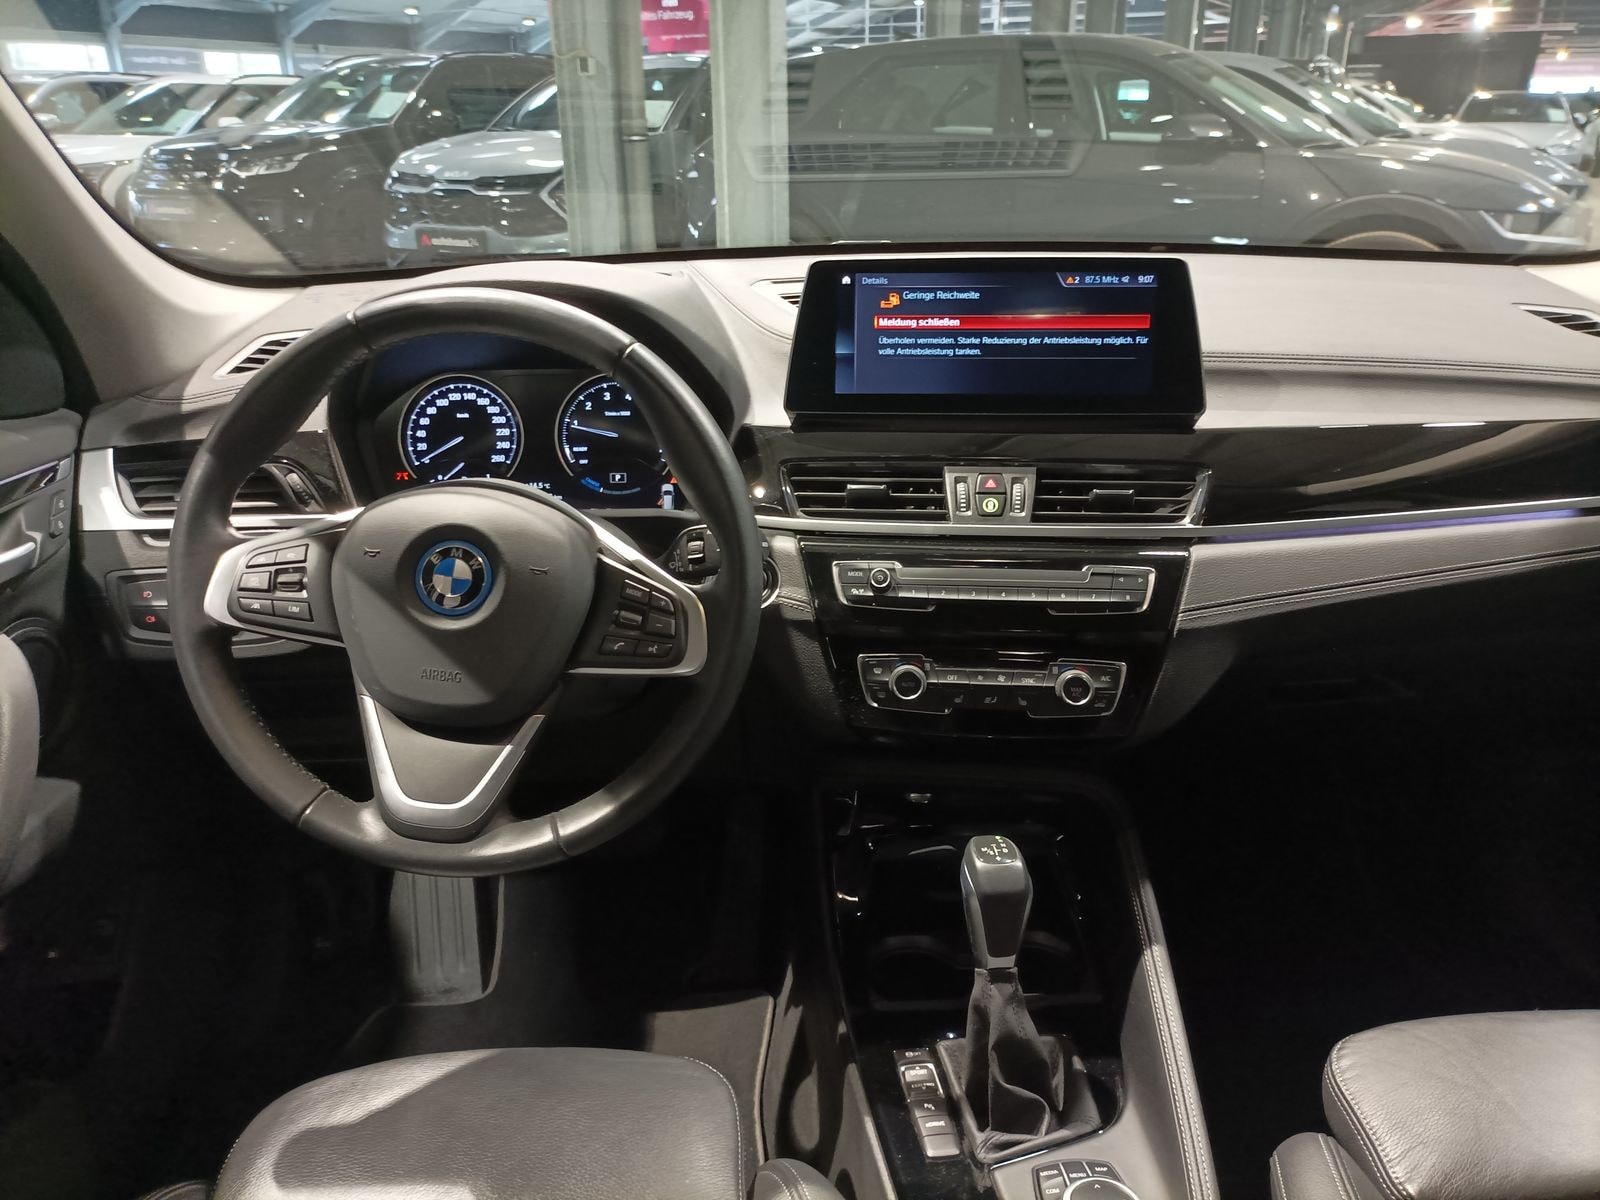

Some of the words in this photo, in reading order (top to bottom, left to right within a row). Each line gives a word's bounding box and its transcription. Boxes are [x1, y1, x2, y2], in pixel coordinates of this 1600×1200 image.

[861, 277, 889, 285] Details
[1084, 275, 1101, 283] 87.5
[1101, 275, 1119, 283] MHz
[1137, 275, 1154, 283] 9:07
[902, 290, 935, 301] Geringe
[936, 290, 980, 300] Reichweite
[878, 317, 917, 328] Meldung
[918, 317, 961, 327] schließen
[878, 335, 916, 345] Überholen
[917, 336, 956, 345] vermeiden.
[957, 336, 981, 345] Starke
[982, 336, 1028, 346] Reduzierung
[1028, 336, 1042, 345] der
[1042, 336, 1102, 346] Antriebsleistung
[1103, 336, 1135, 346] möglich.
[1136, 335, 1149, 345] Für
[878, 347, 895, 355] volle
[896, 347, 954, 357] Antriebsleistung
[955, 347, 981, 355] tanken.
[448, 393, 462, 401] 120
[603, 392, 611, 401] 3
[625, 393, 632, 401] 4
[435, 399, 449, 407] 100
[476, 398, 490, 406] 160
[585, 402, 593, 410] 2
[426, 407, 437, 415] 80
[486, 406, 500, 414] 180
[419, 417, 430, 425] 60
[491, 416, 507, 424] 200
[415, 430, 427, 438] 40
[495, 428, 510, 436] 220
[416, 443, 428, 451] 20
[496, 441, 511, 449] 240
[491, 455, 506, 463] 260
[615, 474, 621, 482] P
[430, 548, 482, 571] BMW
[420, 667, 463, 684] AIRBAG
